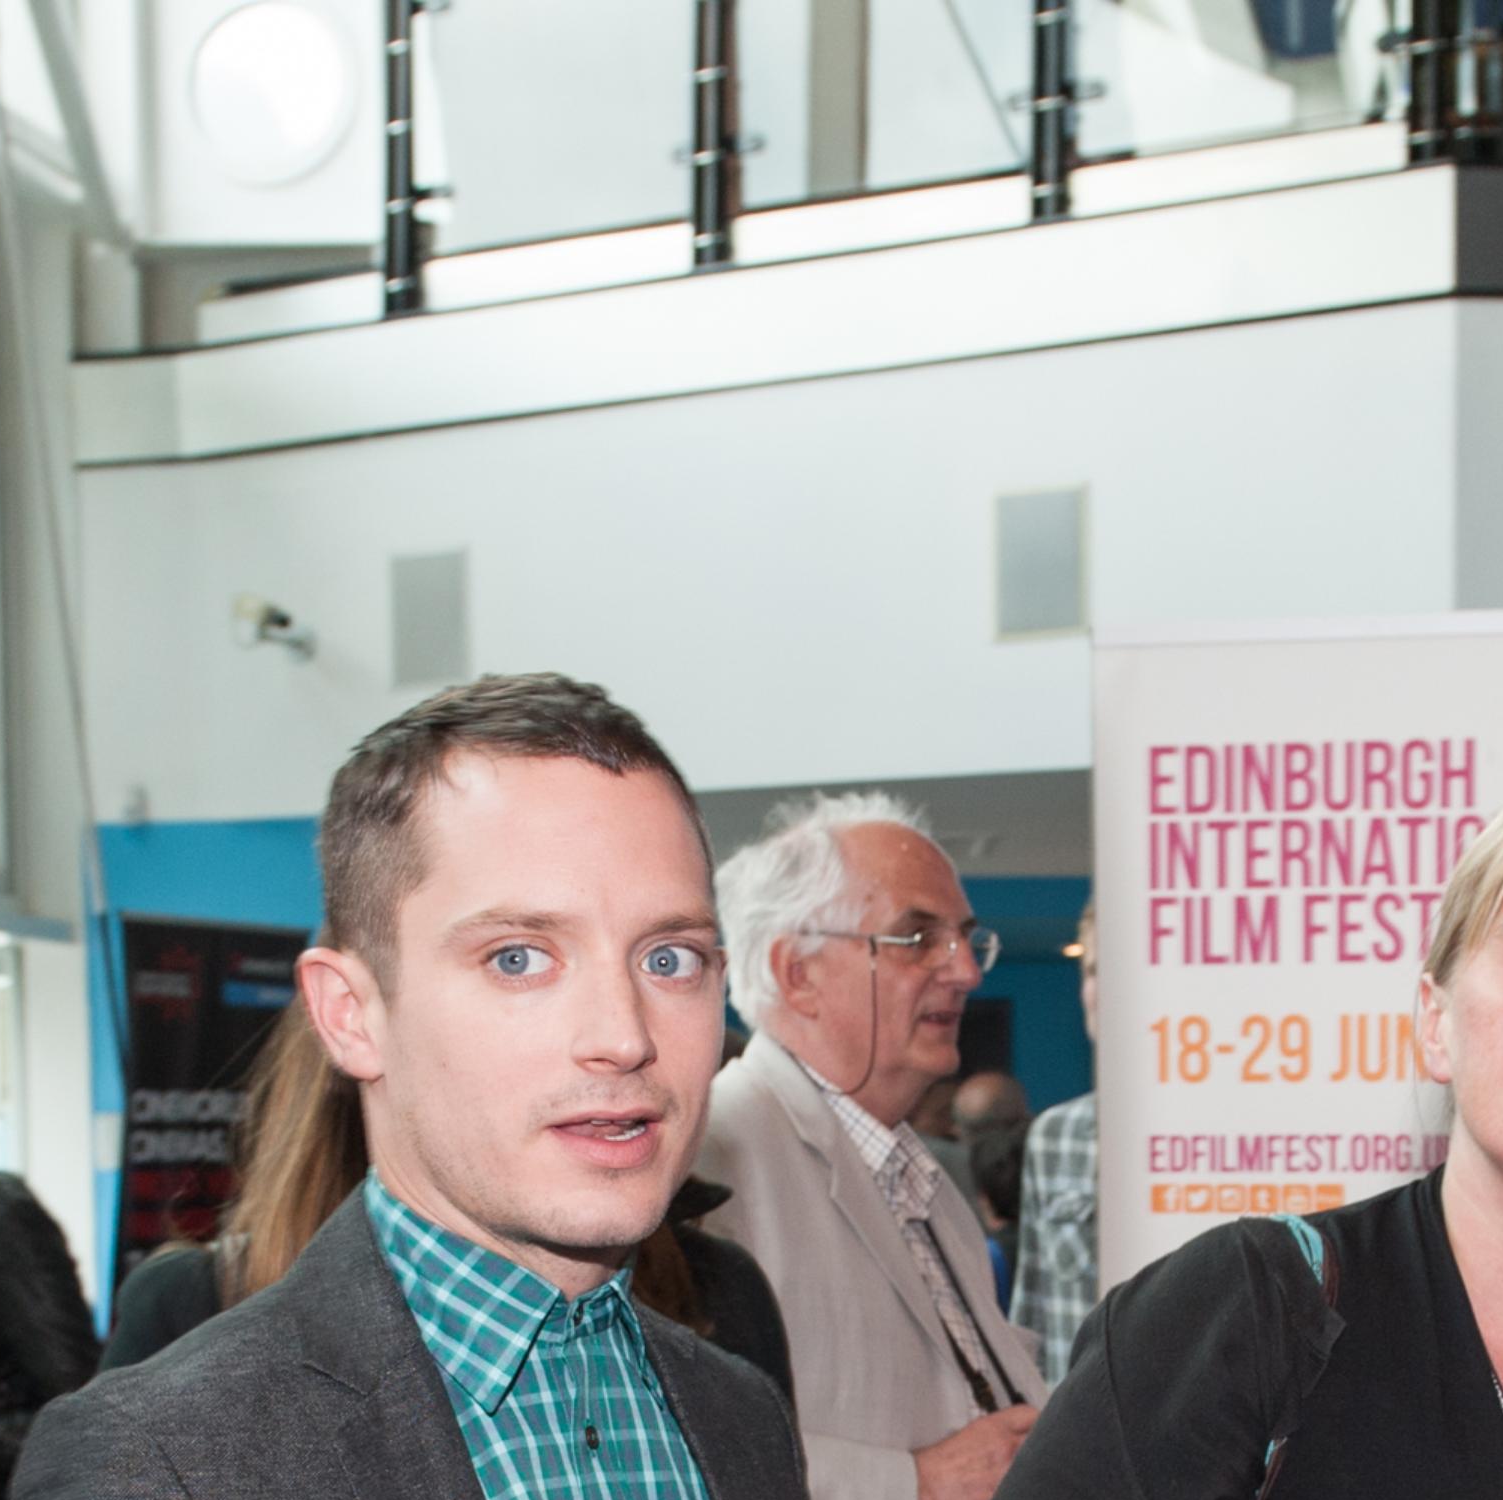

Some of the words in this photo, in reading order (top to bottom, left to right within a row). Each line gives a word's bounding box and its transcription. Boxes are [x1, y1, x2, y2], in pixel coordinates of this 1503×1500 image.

[1149, 738, 1476, 815] EDINBURGH
[1149, 895, 1280, 966] FILM
[1150, 1012, 1312, 1083] 18-29
[1149, 1131, 1451, 1174] EDFILMFEST.ORG.U
